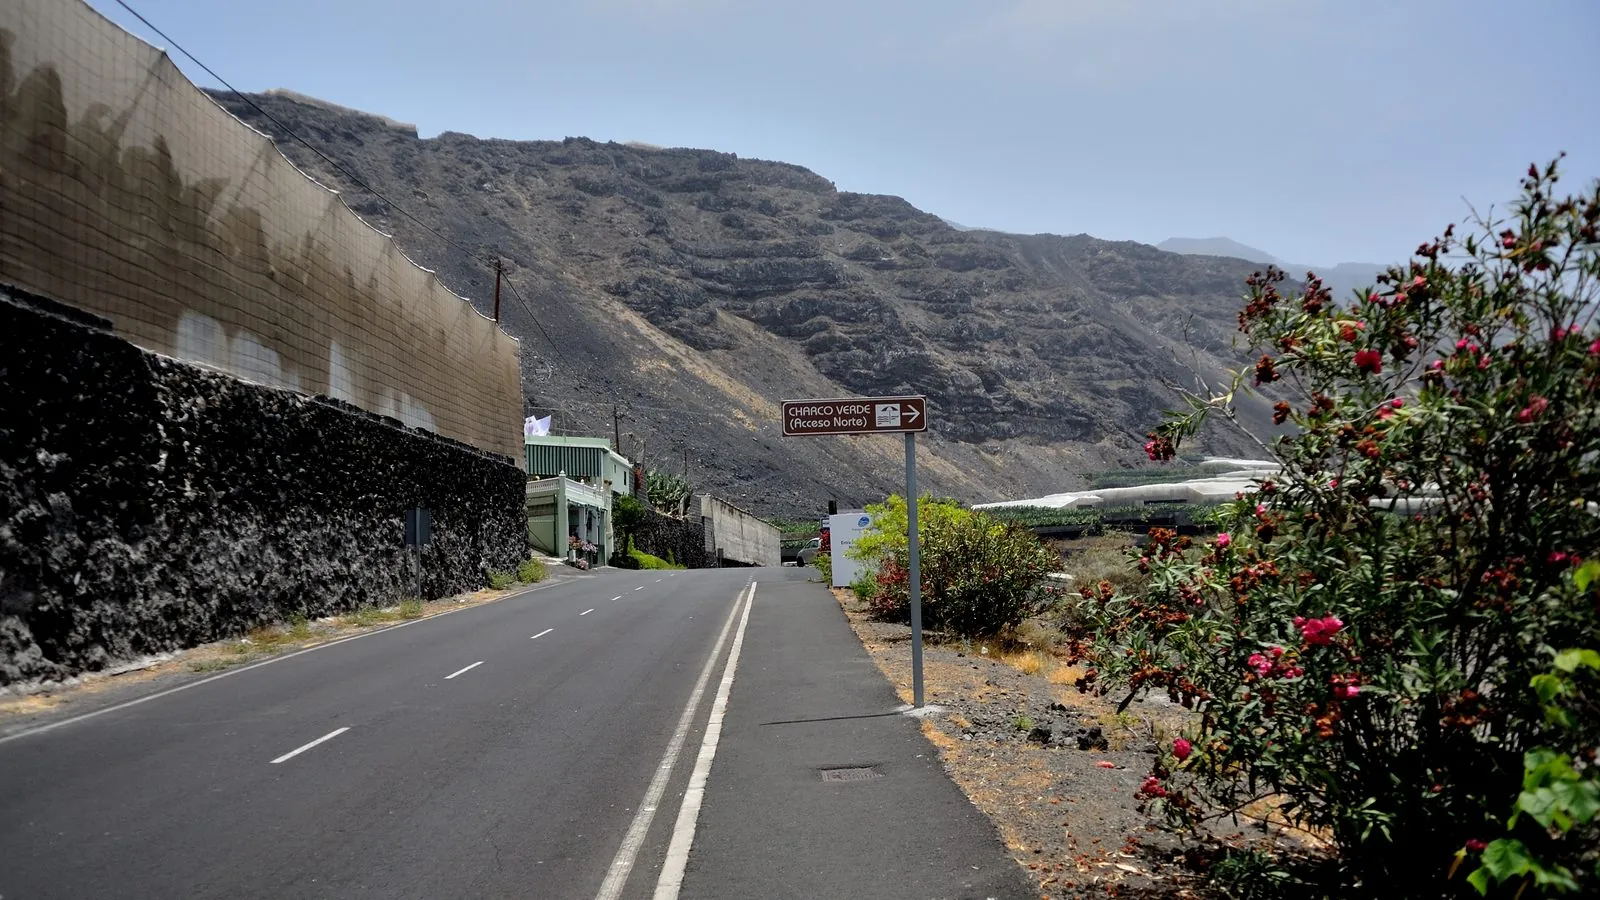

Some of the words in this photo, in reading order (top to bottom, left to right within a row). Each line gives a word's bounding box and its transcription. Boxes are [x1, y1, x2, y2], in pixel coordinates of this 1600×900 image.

[788, 405, 833, 417] CHARCO
[836, 404, 871, 415] VERDE
[789, 417, 831, 430] (Acceso
[833, 416, 868, 428] Norte)
